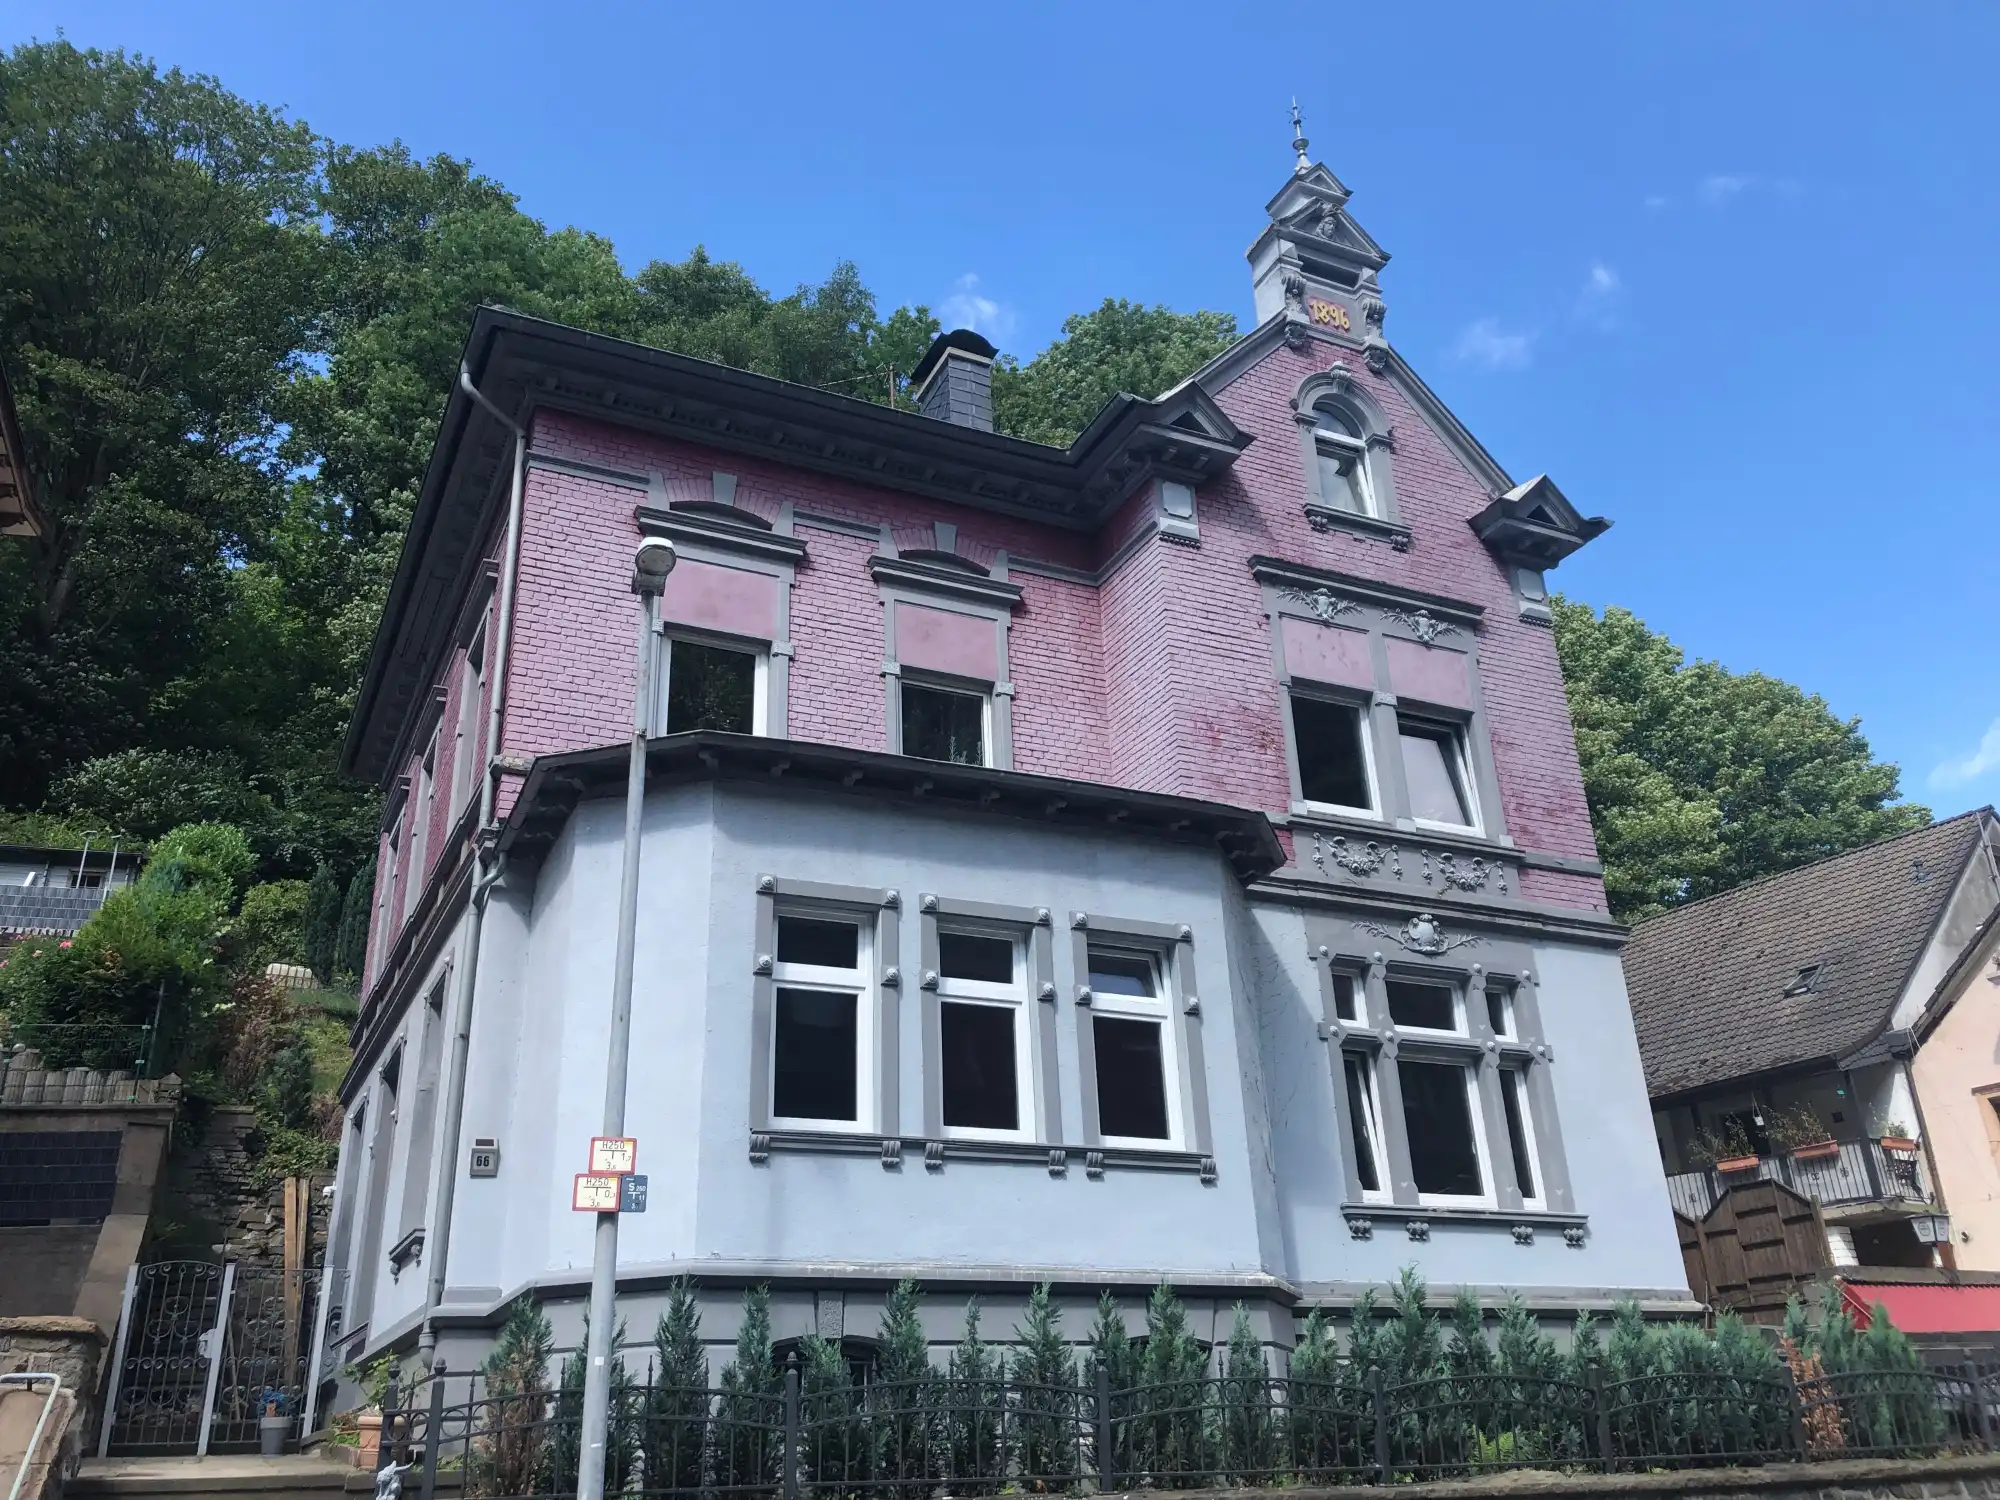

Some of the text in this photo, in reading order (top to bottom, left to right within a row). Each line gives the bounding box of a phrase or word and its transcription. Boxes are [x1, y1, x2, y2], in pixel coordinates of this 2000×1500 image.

[1309, 299, 1350, 331] 1896
[602, 1140, 625, 1150] H250
[476, 1155, 490, 1167] 66
[586, 1177, 609, 1187] H250
